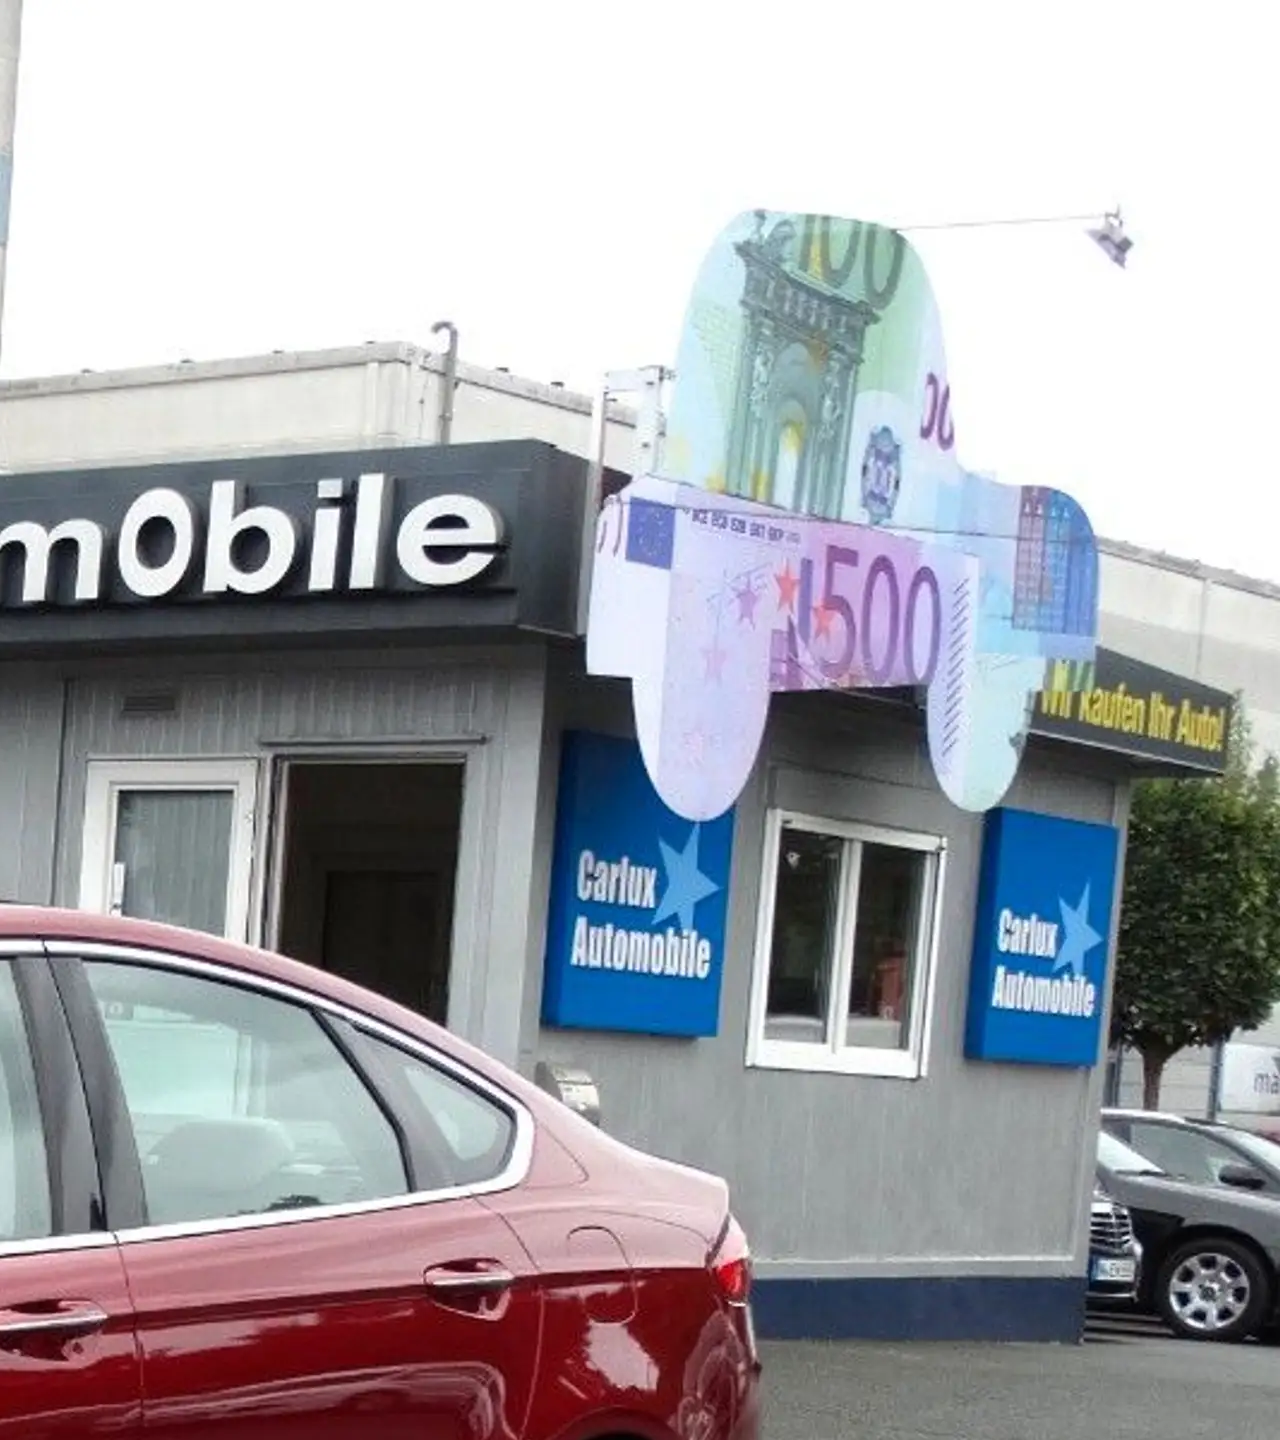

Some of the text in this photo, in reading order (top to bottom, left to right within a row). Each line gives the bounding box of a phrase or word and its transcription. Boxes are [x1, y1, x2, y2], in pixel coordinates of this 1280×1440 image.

[1148, 691, 1177, 740] Ihr
[1176, 699, 1226, 752] Auto!
[577, 849, 657, 909] Carlux
[571, 915, 712, 979] Automobile
[996, 907, 1058, 958] Carlux
[991, 964, 1096, 1018] Automobile
